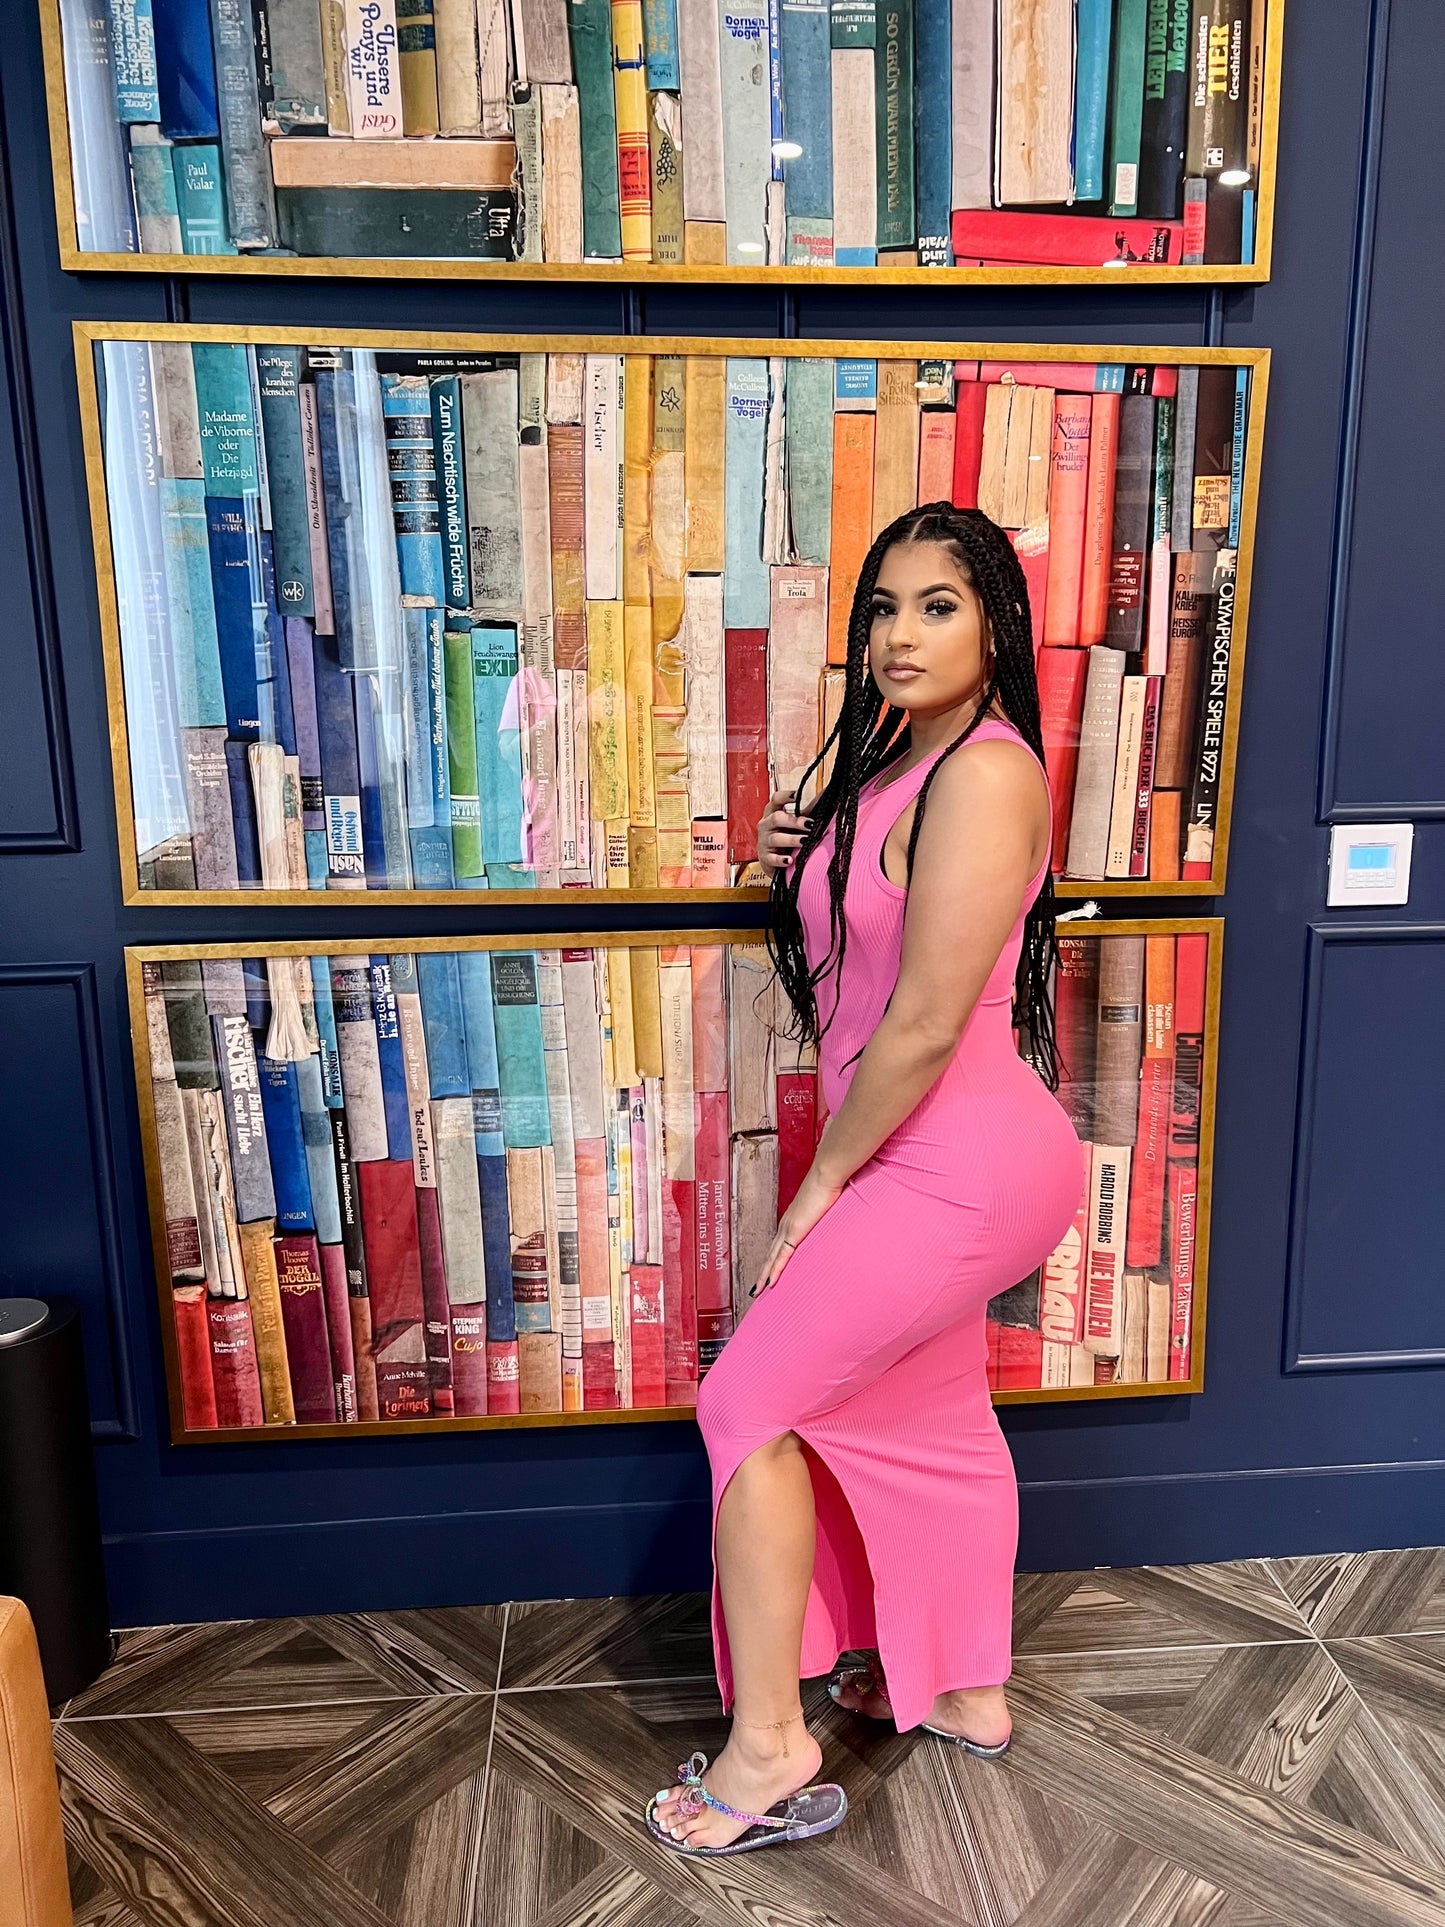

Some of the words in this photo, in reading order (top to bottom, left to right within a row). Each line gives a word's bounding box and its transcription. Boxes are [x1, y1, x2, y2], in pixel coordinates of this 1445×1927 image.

[725, 15, 766, 26] Dornen
[770, 20, 779, 35] den
[886, 12, 899, 38] SO
[359, 3, 381, 62] Ponys
[770, 36, 779, 49] An
[1166, 0, 1188, 72] Mexico
[136, 15, 154, 86] Königlich
[375, 24, 395, 95] Unsere
[1195, 16, 1208, 83] schönsten
[1207, 23, 1229, 97] TIER
[1228, 19, 1242, 101] Geschichten
[351, 46, 367, 79] wir
[771, 58, 780, 78] Wehr
[365, 70, 383, 107] und
[771, 79, 781, 99] Jörg
[1194, 83, 1206, 107] Die
[361, 114, 396, 132] Gast
[886, 91, 899, 136] WAR
[265, 377, 295, 387] kranken
[281, 368, 295, 377] des
[737, 374, 766, 384] Colleen
[261, 387, 296, 396] Menschen
[731, 396, 769, 407] Dornen
[205, 411, 247, 422] Madame
[439, 394, 454, 428] Zum
[1233, 390, 1244, 431] GRAMMAR
[201, 426, 214, 437] de
[214, 426, 253, 437] Viborne
[1101, 426, 1109, 451] Palmer
[218, 440, 239, 451] oder
[1064, 442, 1080, 451] Der
[1233, 434, 1242, 458] GUIDE
[222, 452, 239, 464] Die
[442, 430, 460, 505] Nachtisch
[1056, 462, 1084, 472] bruder
[211, 466, 253, 480] Hetzjagd
[1232, 461, 1241, 478] NEW
[1231, 481, 1240, 496] THE
[1097, 486, 1106, 520] Tagebuch
[221, 513, 243, 523] WILL
[312, 511, 321, 529] Otto
[446, 505, 460, 543] wilde
[449, 544, 465, 598] Früchte
[1174, 601, 1198, 610] KRIEG
[540, 612, 552, 634] Arno
[1209, 582, 1235, 696] OLYMPISCHEN
[238, 719, 261, 727] Lingen
[1144, 705, 1156, 730] DAS
[1203, 699, 1225, 747] SPIELE
[1140, 765, 1152, 788] DER
[1200, 749, 1219, 783] 1972
[329, 797, 340, 815] und
[1137, 789, 1150, 808] 333
[329, 815, 344, 853] Regen
[344, 811, 360, 852] Ostwind
[329, 854, 365, 875] Nash
[1071, 950, 1083, 959] Die
[386, 993, 396, 1009] an
[1164, 1003, 1174, 1030] Keun
[223, 1016, 251, 1092] Fischer
[268, 1079, 288, 1087] Tigers
[271, 1072, 282, 1080] des
[328, 1050, 342, 1097] KONSALIK
[1147, 1062, 1161, 1104] Reporter
[232, 1094, 249, 1124] sucht
[247, 1092, 262, 1110] Ein
[250, 1111, 264, 1138] Herz
[414, 1108, 425, 1127] Tod
[1147, 1107, 1159, 1140] rasende
[237, 1126, 252, 1155] Liebe
[416, 1127, 427, 1145] auf
[1144, 1140, 1156, 1161] Der
[340, 1163, 349, 1174] Im
[418, 1145, 430, 1182] Leukas
[712, 1180, 726, 1203] Janet
[1099, 1163, 1116, 1200] HAROLD
[341, 1174, 355, 1225] Hollerbachtal
[698, 1181, 709, 1214] Mitten
[280, 1211, 308, 1220] LINGEN
[698, 1214, 708, 1235] ins
[1097, 1201, 1115, 1245] ROBBINS
[714, 1204, 729, 1271] Evanovich
[1174, 1191, 1197, 1279] Bewerbungs
[281, 1249, 310, 1258] Thomas
[282, 1256, 310, 1264] Hoover
[699, 1235, 709, 1271] Herz
[1091, 1250, 1116, 1277] DIE
[279, 1273, 320, 1284] MOGUL
[287, 1265, 310, 1275] DER
[1088, 1276, 1115, 1339] WILDEN
[1175, 1281, 1194, 1323] Paket
[210, 1311, 249, 1322] Konsalik
[452, 1317, 483, 1326] STEPHEN
[455, 1324, 480, 1335] KING
[454, 1337, 485, 1354] Cujo
[383, 1371, 402, 1381] Anne
[401, 1370, 427, 1379] Melville
[342, 1373, 355, 1410] Barbara
[398, 1386, 417, 1399] Die
